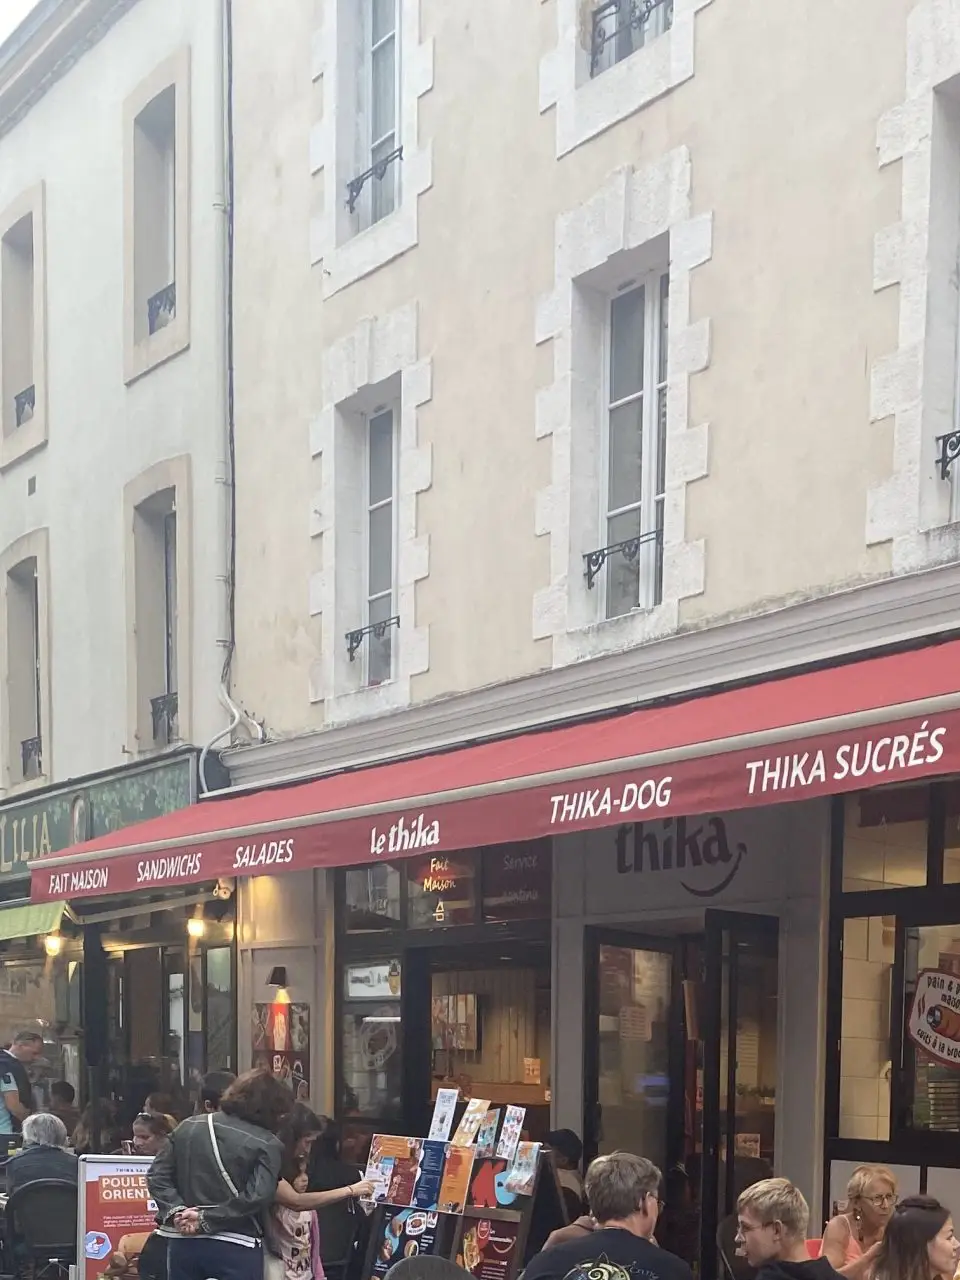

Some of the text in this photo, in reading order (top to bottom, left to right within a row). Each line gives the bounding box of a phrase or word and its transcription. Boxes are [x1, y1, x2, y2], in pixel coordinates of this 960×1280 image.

[745, 720, 947, 794] THIKA SUCRÉS
[550, 776, 673, 824] THIKA-DOG
[370, 813, 440, 855] le thika
[614, 816, 733, 875] thika
[136, 852, 202, 883] SANDWICHS
[232, 838, 294, 869] SALADES
[430, 857, 450, 874] Fait
[49, 867, 109, 895] FAIT MAISON
[423, 875, 457, 893] Maison
